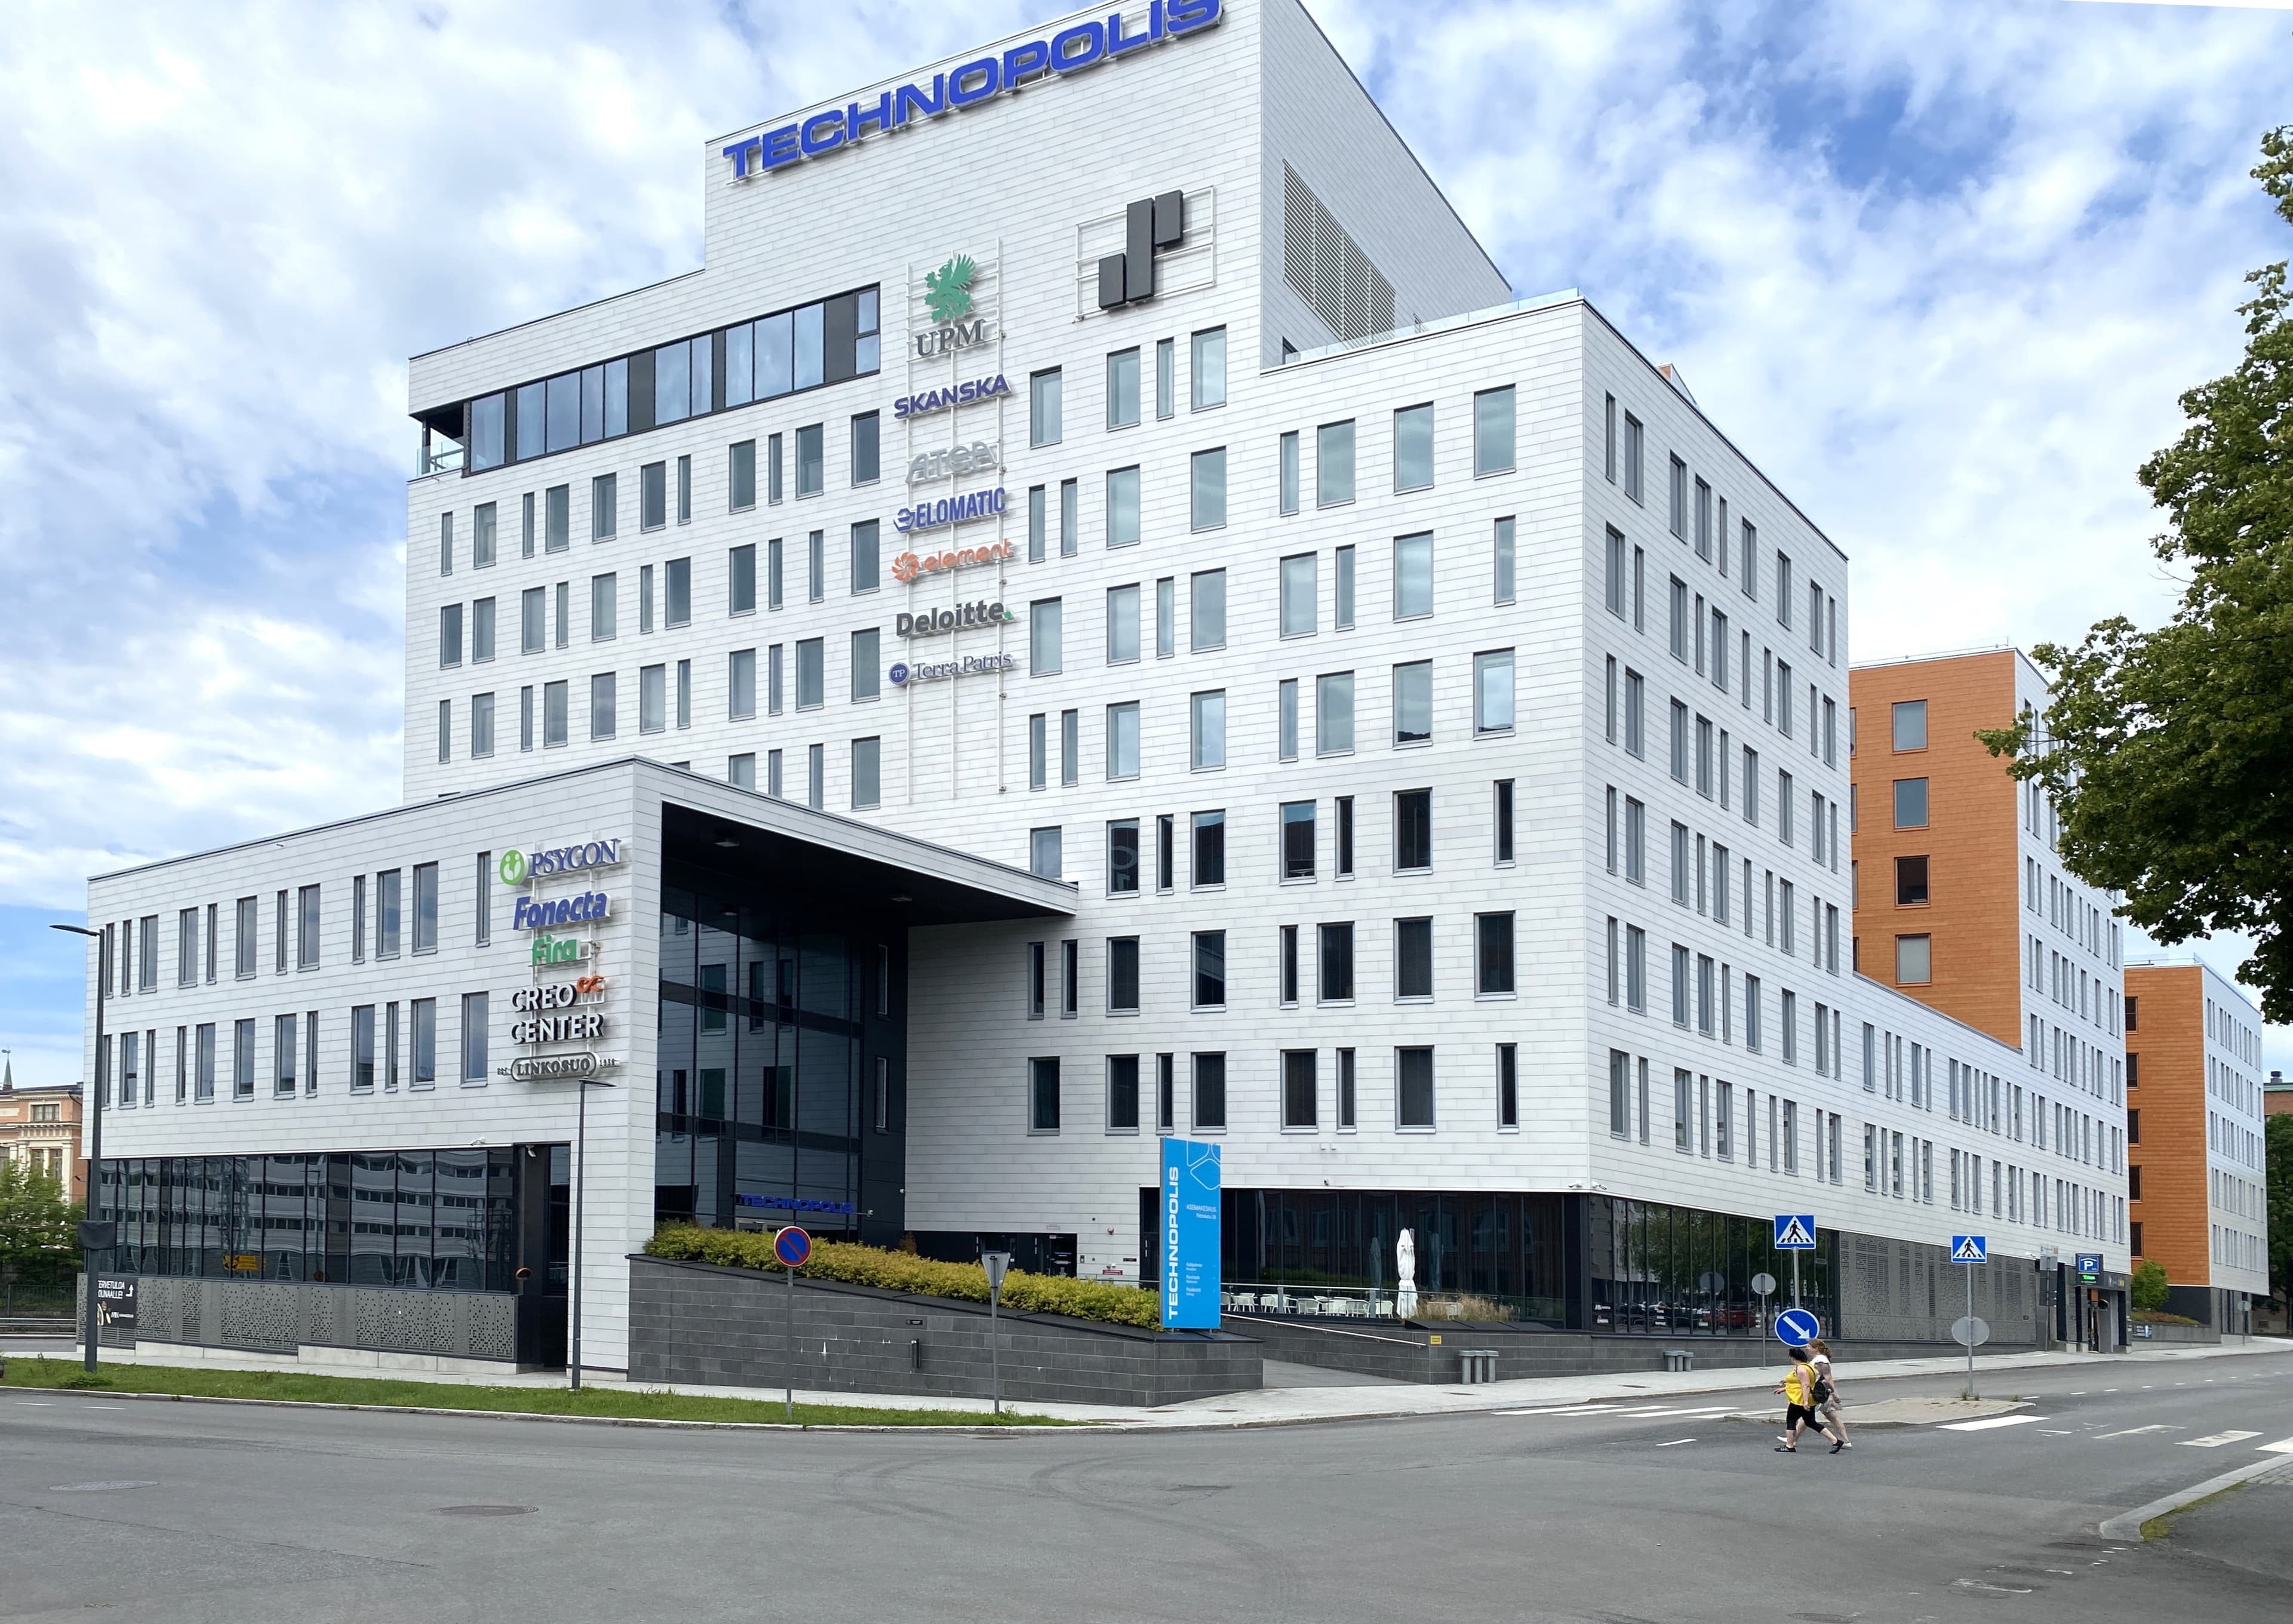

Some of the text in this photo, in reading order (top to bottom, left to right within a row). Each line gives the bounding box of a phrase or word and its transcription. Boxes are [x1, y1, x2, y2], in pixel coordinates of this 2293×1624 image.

[723, 0, 1223, 180] TECHNOPOLIS
[915, 319, 986, 356] UPM
[894, 374, 1010, 419] SKANSKA
[917, 487, 1006, 528] ELOMATIC
[924, 538, 1013, 571] element
[913, 651, 1012, 679] Terra Patris
[531, 838, 621, 878] PSYCON
[513, 891, 609, 931] Fonecta
[512, 983, 577, 1013] CREO
[511, 1013, 604, 1045] CENTER
[517, 1058, 590, 1076] LINKOSUO
[739, 1194, 854, 1214] TECHNOPOLIS
[1168, 1166, 1179, 1320] TECHNOPOLIS
[2084, 1261, 2094, 1270] P
